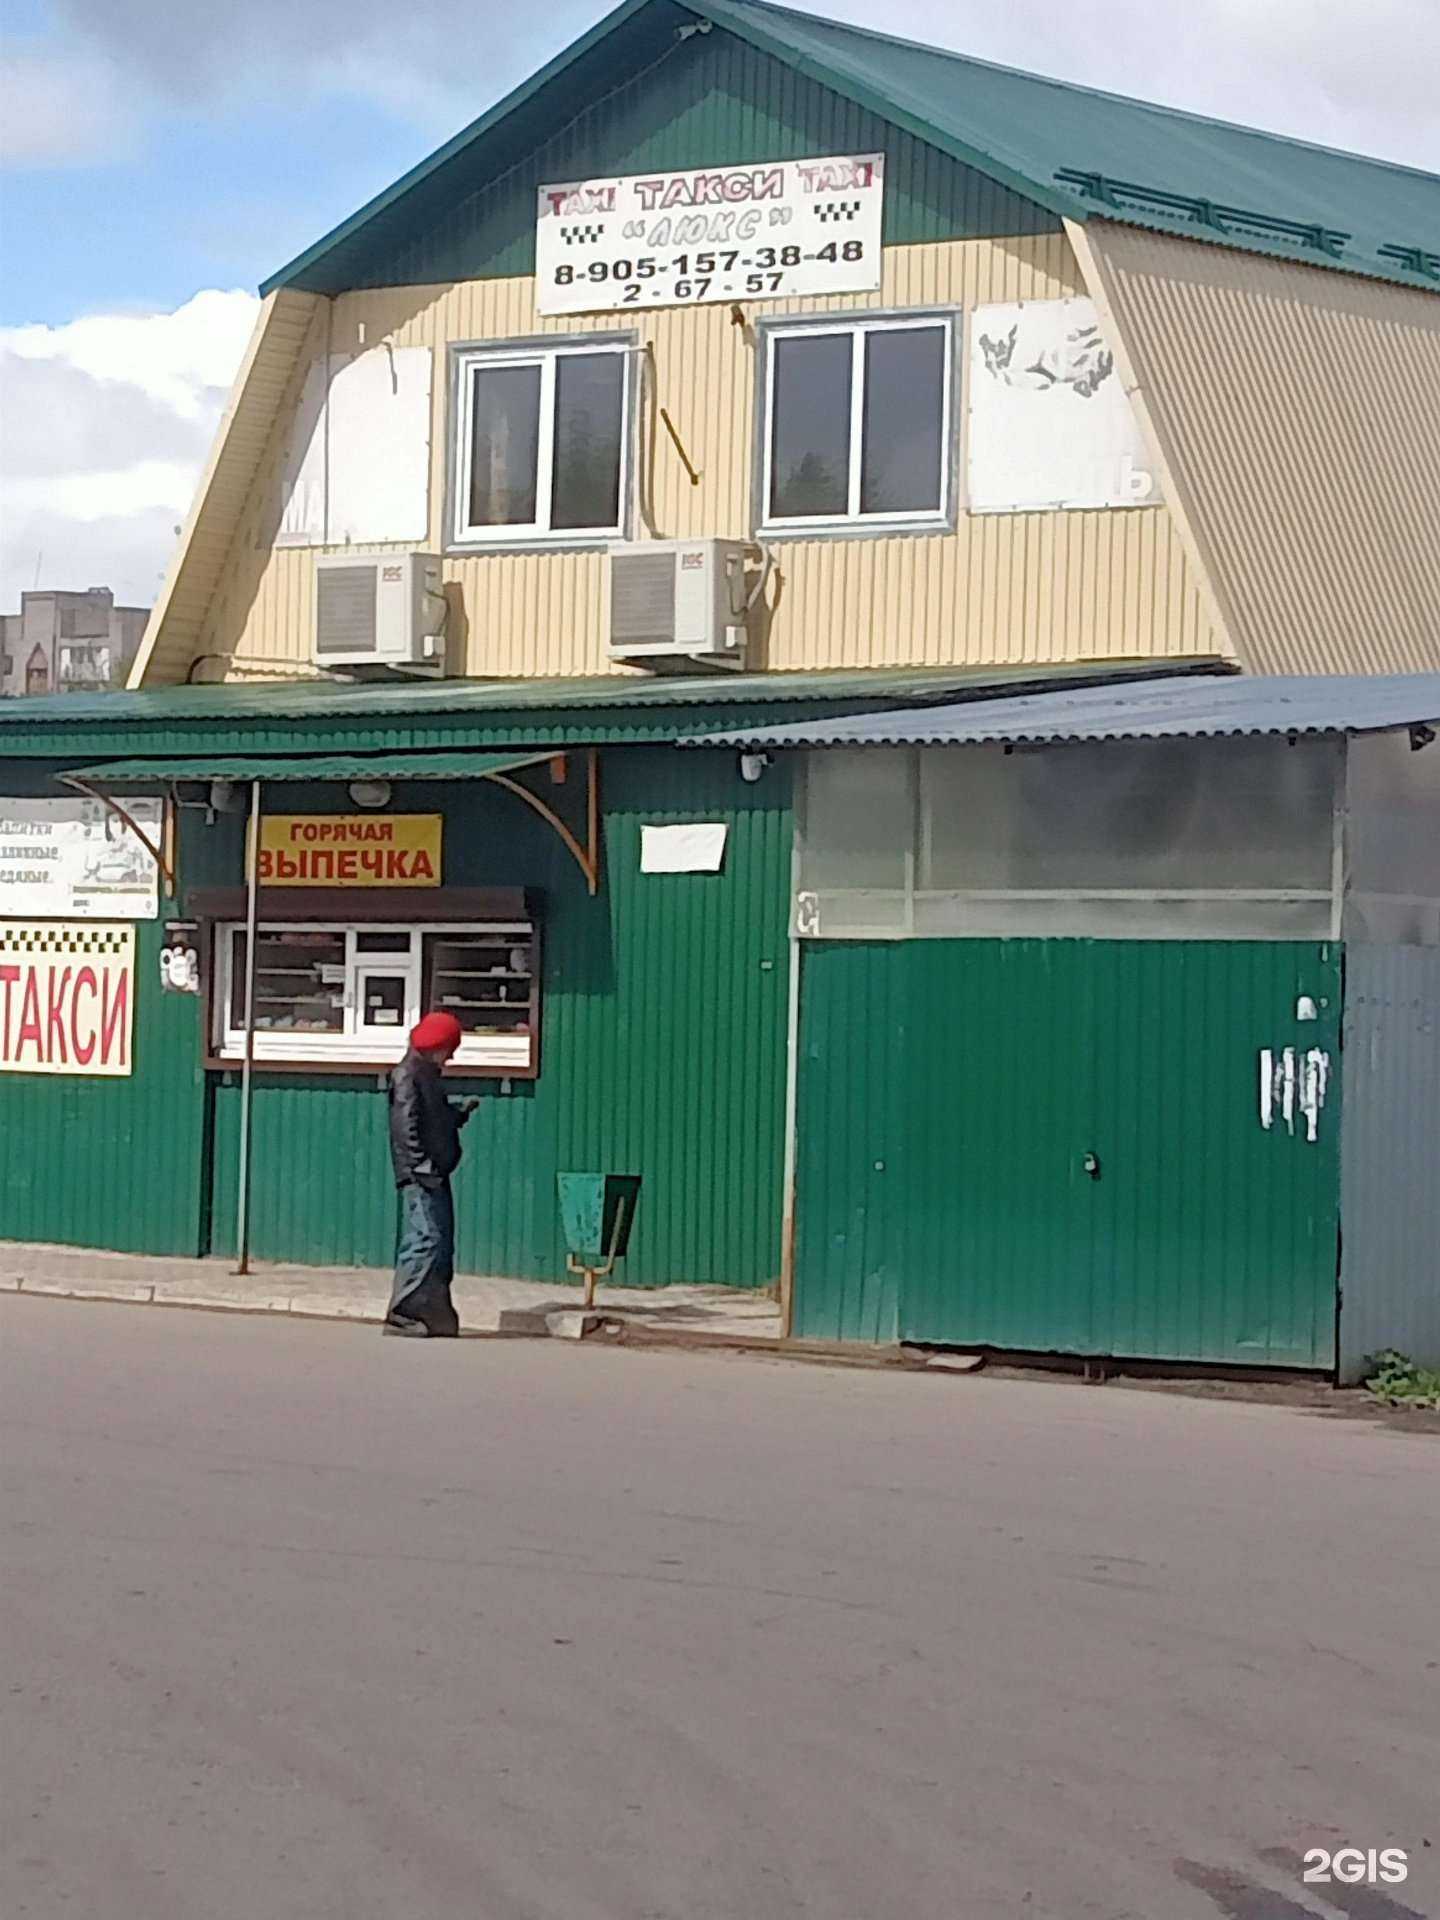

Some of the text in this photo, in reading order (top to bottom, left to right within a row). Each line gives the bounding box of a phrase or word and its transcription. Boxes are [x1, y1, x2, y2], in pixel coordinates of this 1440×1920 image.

[634, 168, 784, 211] ТАКСИ
[554, 240, 864, 286] 8-905-157-38-48
[290, 823, 393, 842] ГОРЯЧАЯ
[0, 965, 128, 1066] ТАКСИ
